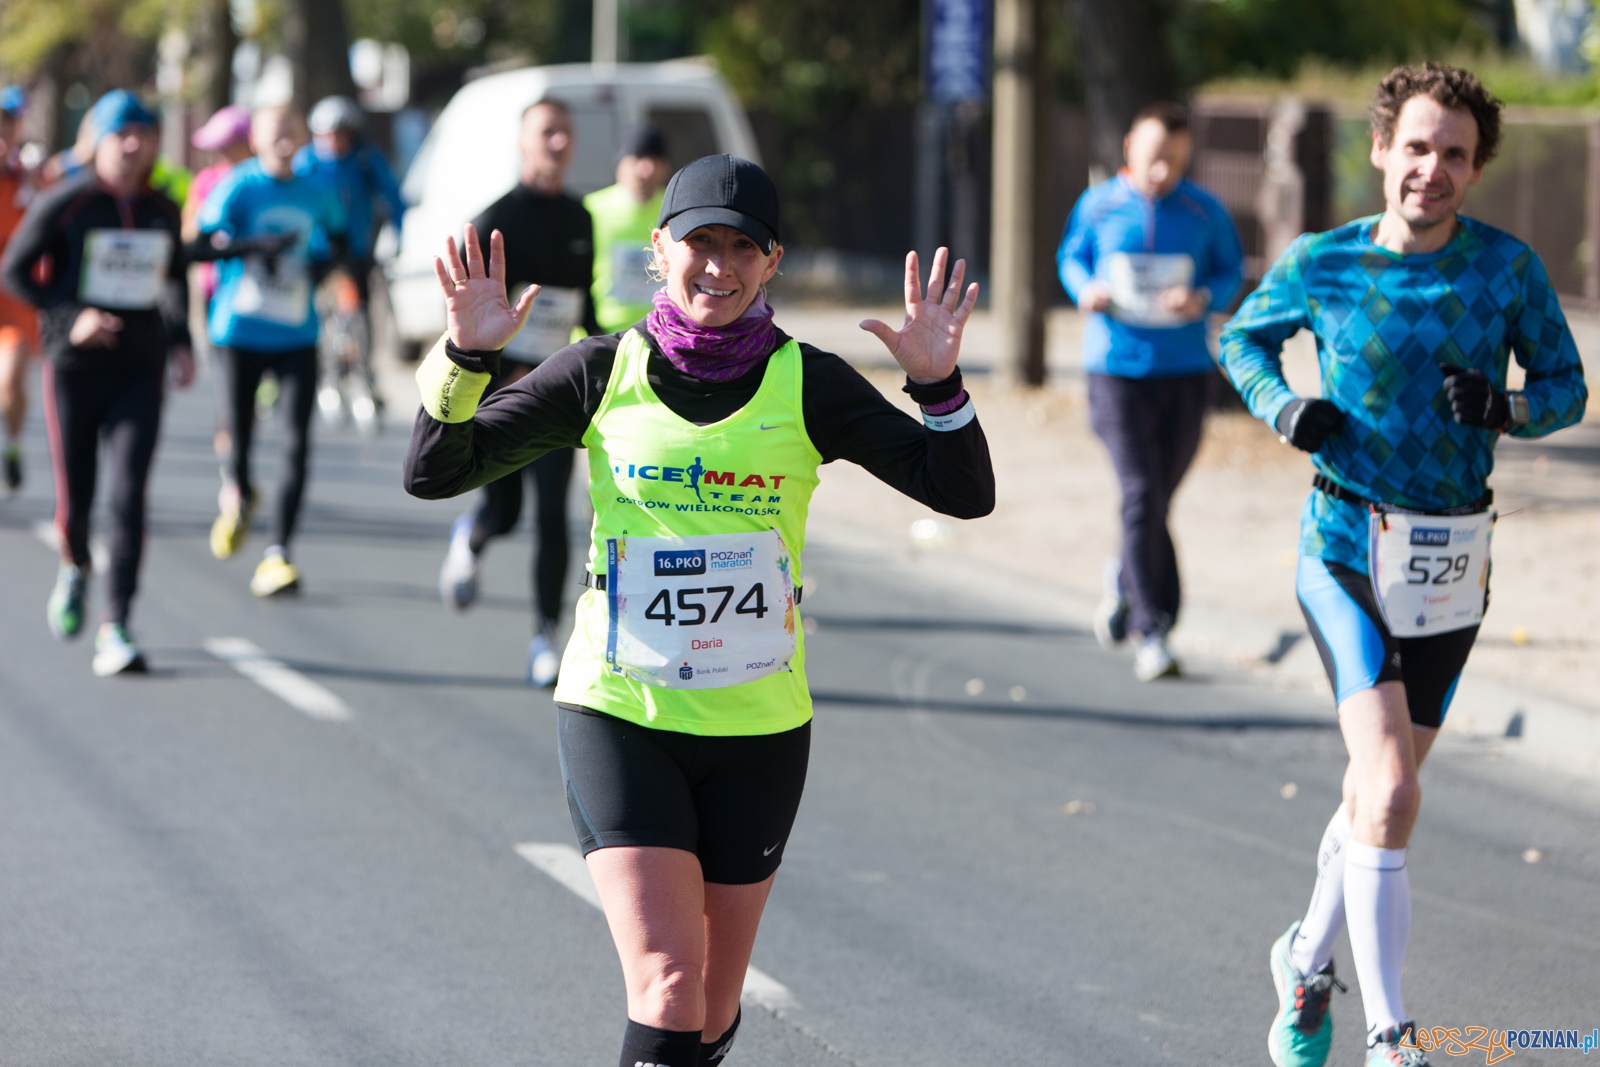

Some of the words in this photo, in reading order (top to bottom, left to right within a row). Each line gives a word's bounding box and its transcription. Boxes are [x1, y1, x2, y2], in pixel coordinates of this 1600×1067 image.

[628, 464, 685, 483] ICE
[703, 470, 786, 490] MAT
[616, 496, 670, 510] OSTRÓW
[675, 503, 781, 517] WIELKOPOLSKI
[709, 491, 782, 504] TEAM
[710, 558, 753, 569] maraton
[1407, 553, 1470, 585] 529
[644, 582, 769, 627] 4574
[691, 637, 723, 651] Daria
